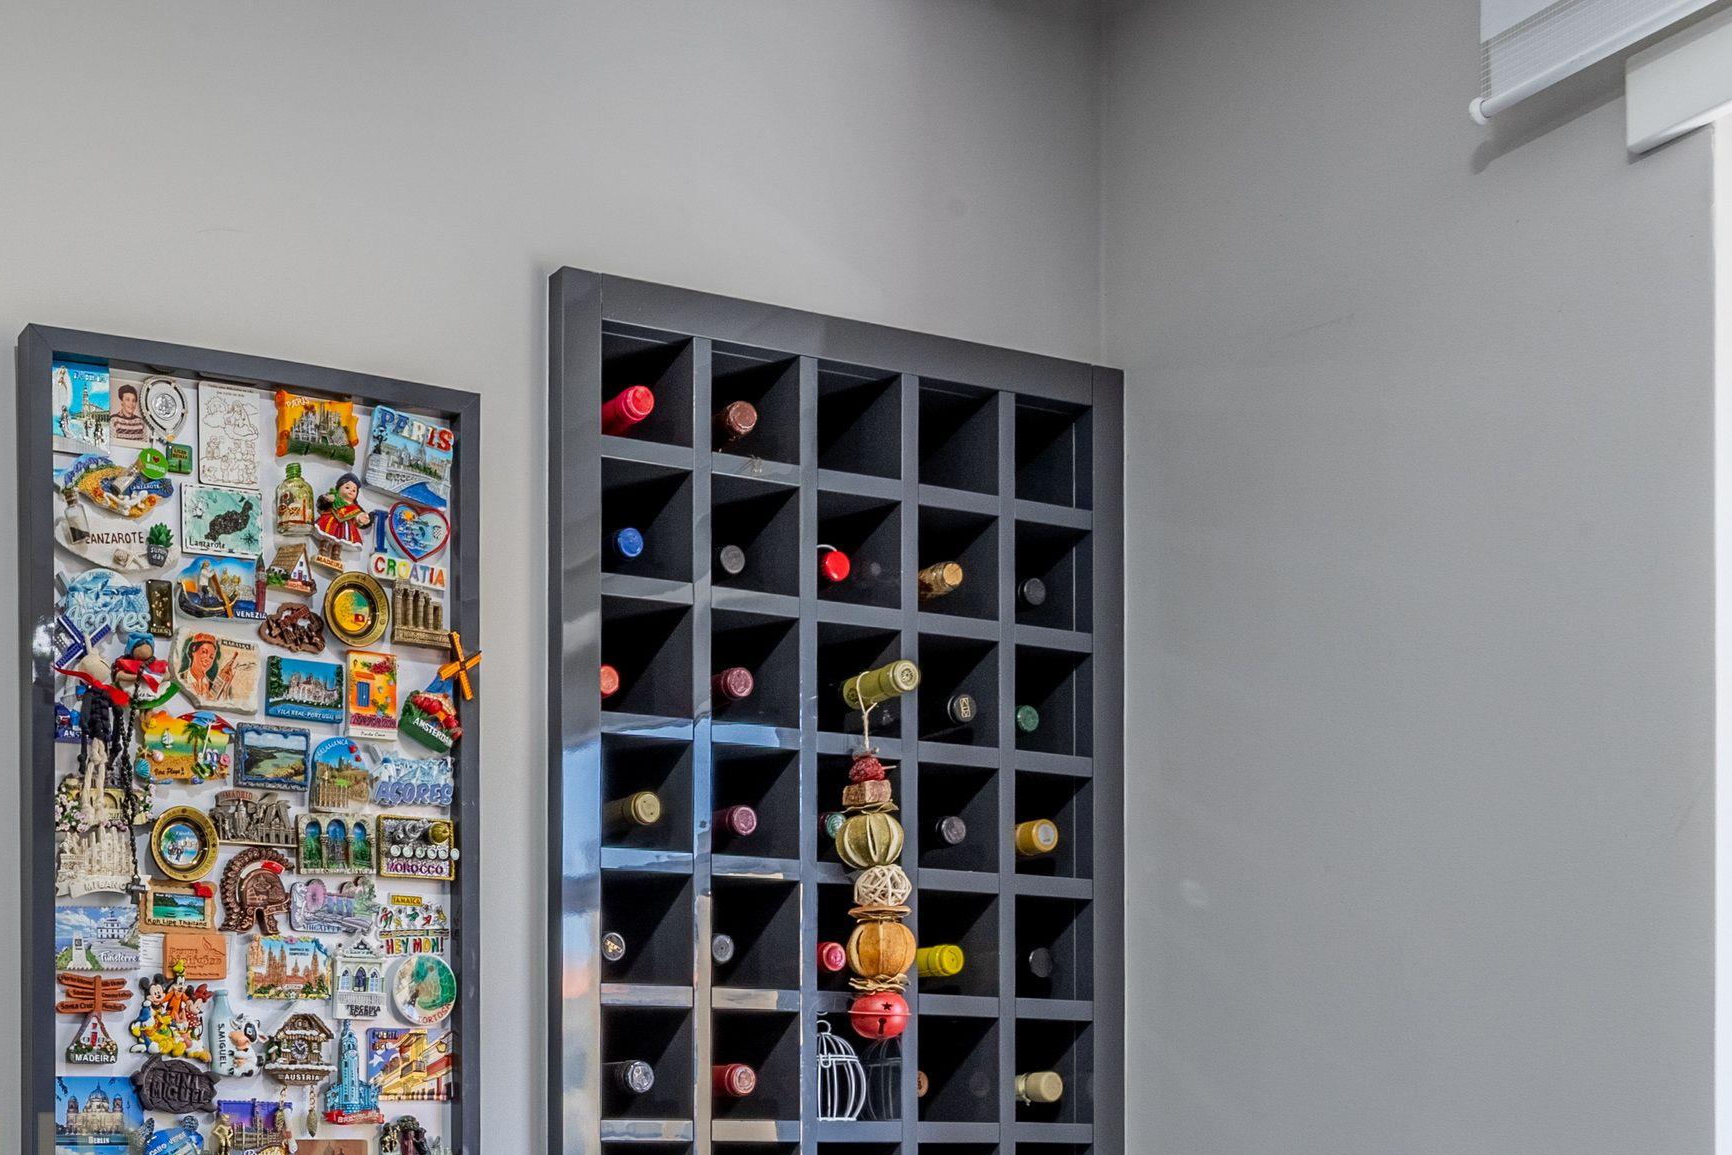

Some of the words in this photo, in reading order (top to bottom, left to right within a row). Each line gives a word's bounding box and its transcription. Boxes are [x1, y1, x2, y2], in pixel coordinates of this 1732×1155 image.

[286, 397, 310, 409] PARIS
[379, 408, 453, 452] PARIS
[374, 509, 389, 553] I
[374, 556, 446, 587] CROATIA
[235, 610, 267, 619] VENEZIA
[374, 780, 453, 807] AÇORES
[386, 862, 444, 875] MOROCCO
[393, 897, 421, 906] JAMAICA
[179, 919, 207, 927] Thailand
[385, 937, 409, 955] HEY
[412, 936, 444, 954] MON!
[75, 1053, 117, 1062] MADEIRA
[284, 1073, 320, 1081] AUSTRIA
[87, 1136, 110, 1144] BERLIN
